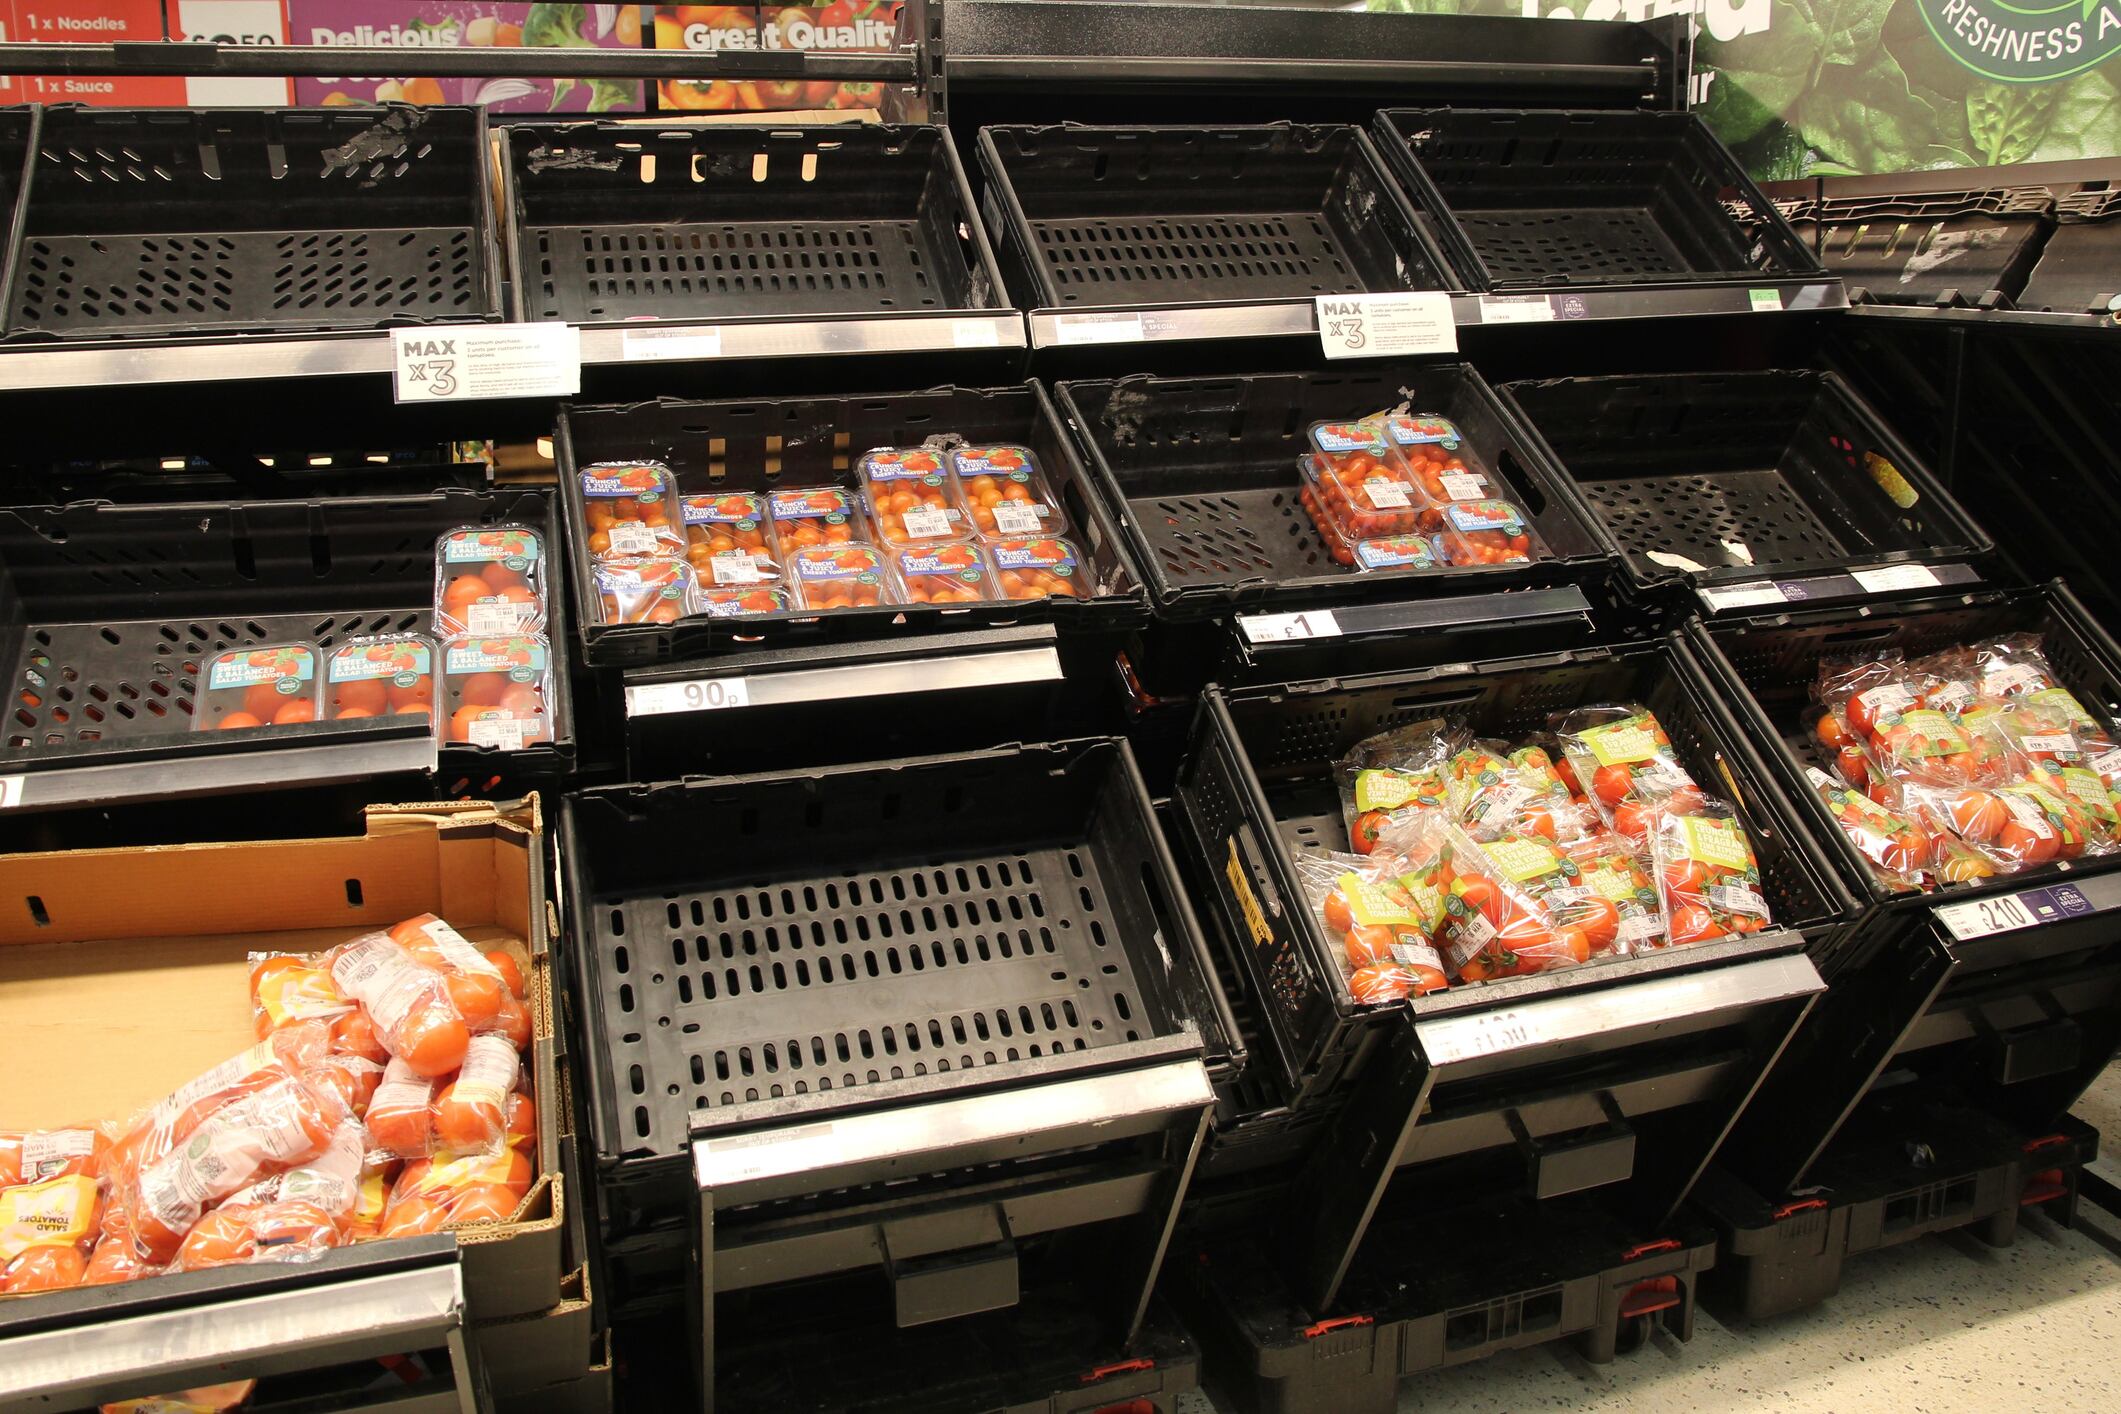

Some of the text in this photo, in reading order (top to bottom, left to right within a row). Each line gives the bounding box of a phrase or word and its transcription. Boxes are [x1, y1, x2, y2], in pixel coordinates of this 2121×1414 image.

[27, 14, 127, 31] 1 x Noodles
[311, 24, 460, 46] Delicious
[684, 22, 781, 50] Great
[35, 77, 114, 93] 1 x Sauce
[1323, 302, 1363, 316] MAX
[403, 339, 457, 357] MAX
[1284, 614, 1314, 638] £1
[683, 681, 738, 708] 90p
[2058, 893, 2079, 901] EXTRA
[2060, 898, 2086, 907] SPECIAL
